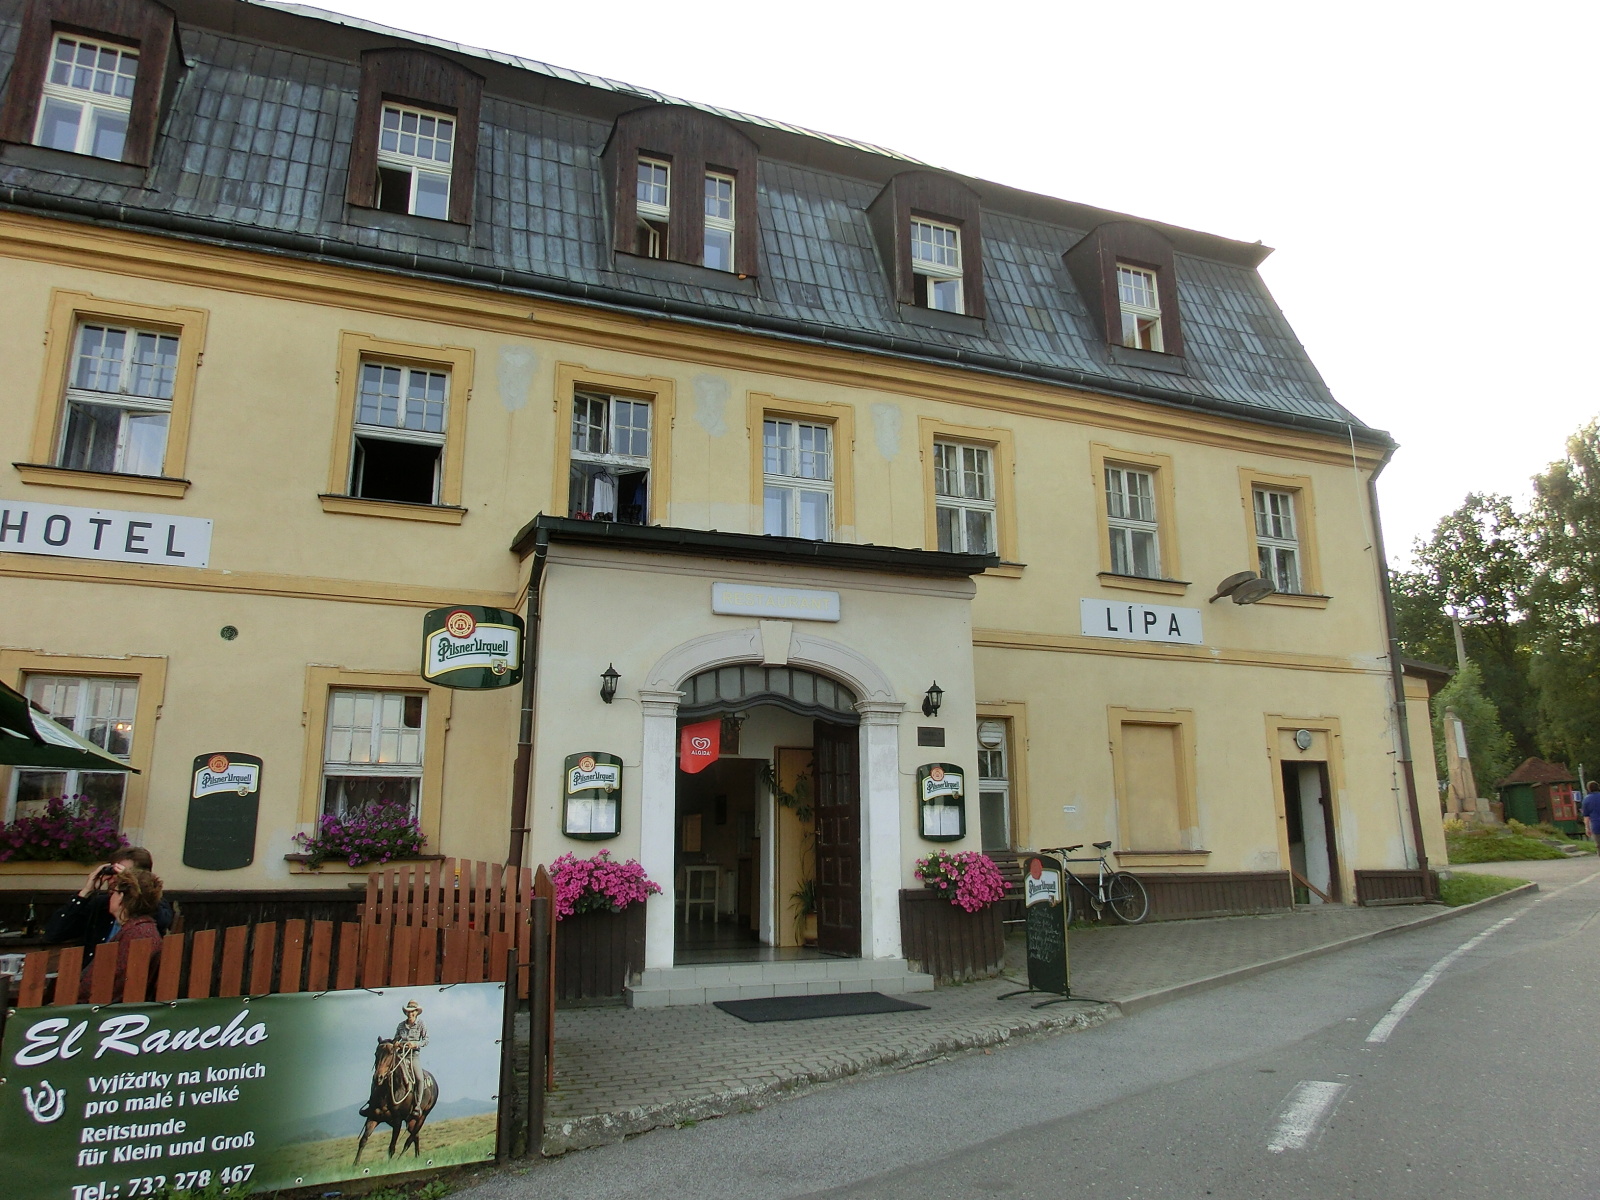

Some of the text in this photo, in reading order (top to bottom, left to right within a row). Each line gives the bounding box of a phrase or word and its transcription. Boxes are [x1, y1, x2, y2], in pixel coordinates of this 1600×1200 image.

[0, 509, 186, 558] HOTEL
[722, 591, 832, 610] RESTAURANT
[1106, 605, 1182, 637] LÍPA
[437, 637, 509, 663] Pilsner Urquell
[202, 772, 252, 789] Pilsner Urquell
[573, 771, 615, 786] Pilsner Urquell
[926, 780, 960, 794] Pilsner Urquell
[14, 1009, 269, 1066] El Rancho
[88, 1062, 267, 1095] Vyjížďky na koních
[84, 1084, 241, 1119] pro malé i velké
[80, 1118, 187, 1144] Reitstunde
[77, 1131, 256, 1167] für Klein und Groß
[71, 1163, 256, 1200] Tel.: 732 278 467
